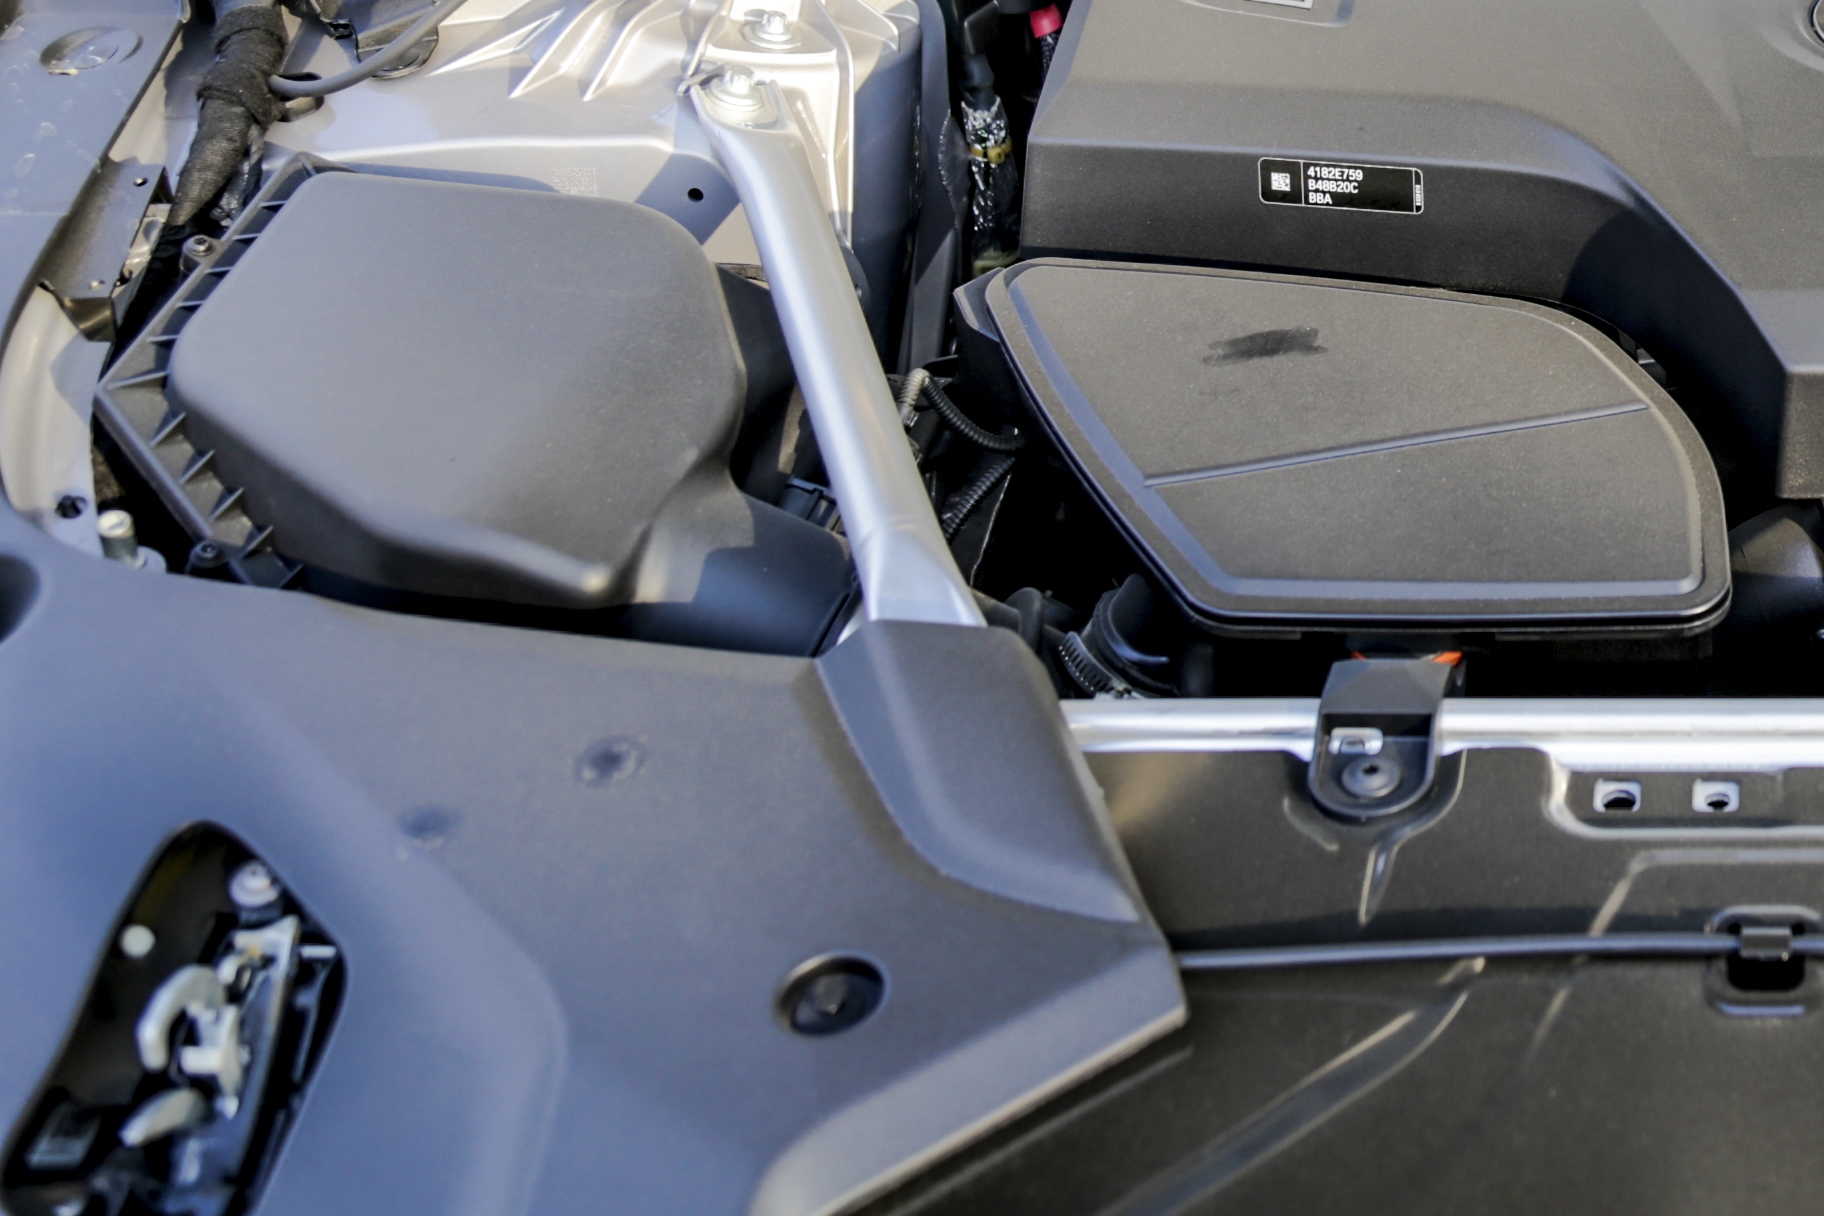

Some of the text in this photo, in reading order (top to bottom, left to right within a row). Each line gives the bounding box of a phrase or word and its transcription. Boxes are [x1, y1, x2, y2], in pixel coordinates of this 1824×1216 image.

[1307, 166, 1363, 181] 4182E759
[1308, 178, 1359, 194] B48B20C
[1308, 191, 1333, 205] BBA
